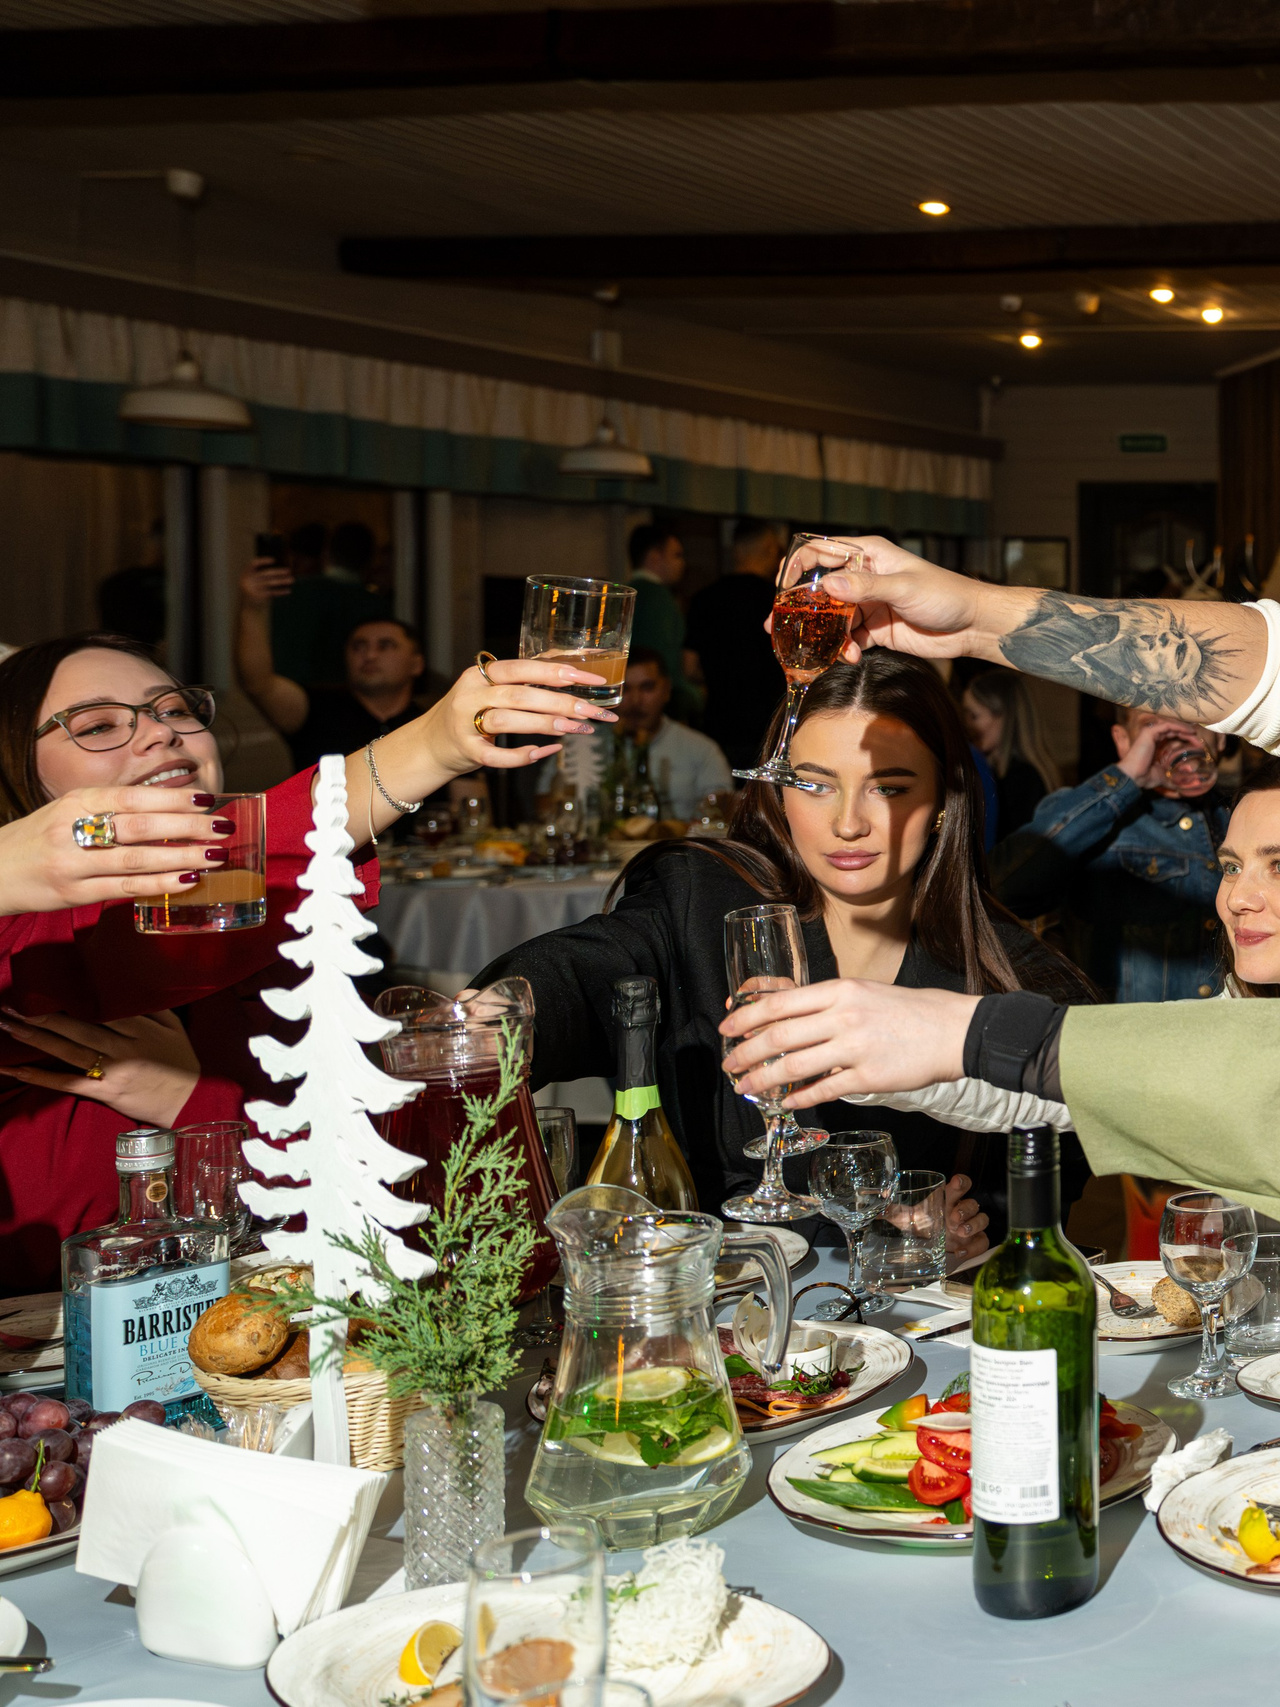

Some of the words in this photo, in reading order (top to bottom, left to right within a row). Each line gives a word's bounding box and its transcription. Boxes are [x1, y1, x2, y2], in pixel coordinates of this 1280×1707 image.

[122, 1296, 223, 1346] BARRIST
[140, 1336, 178, 1357] BLUE
[142, 1349, 177, 1363] DELICATE
